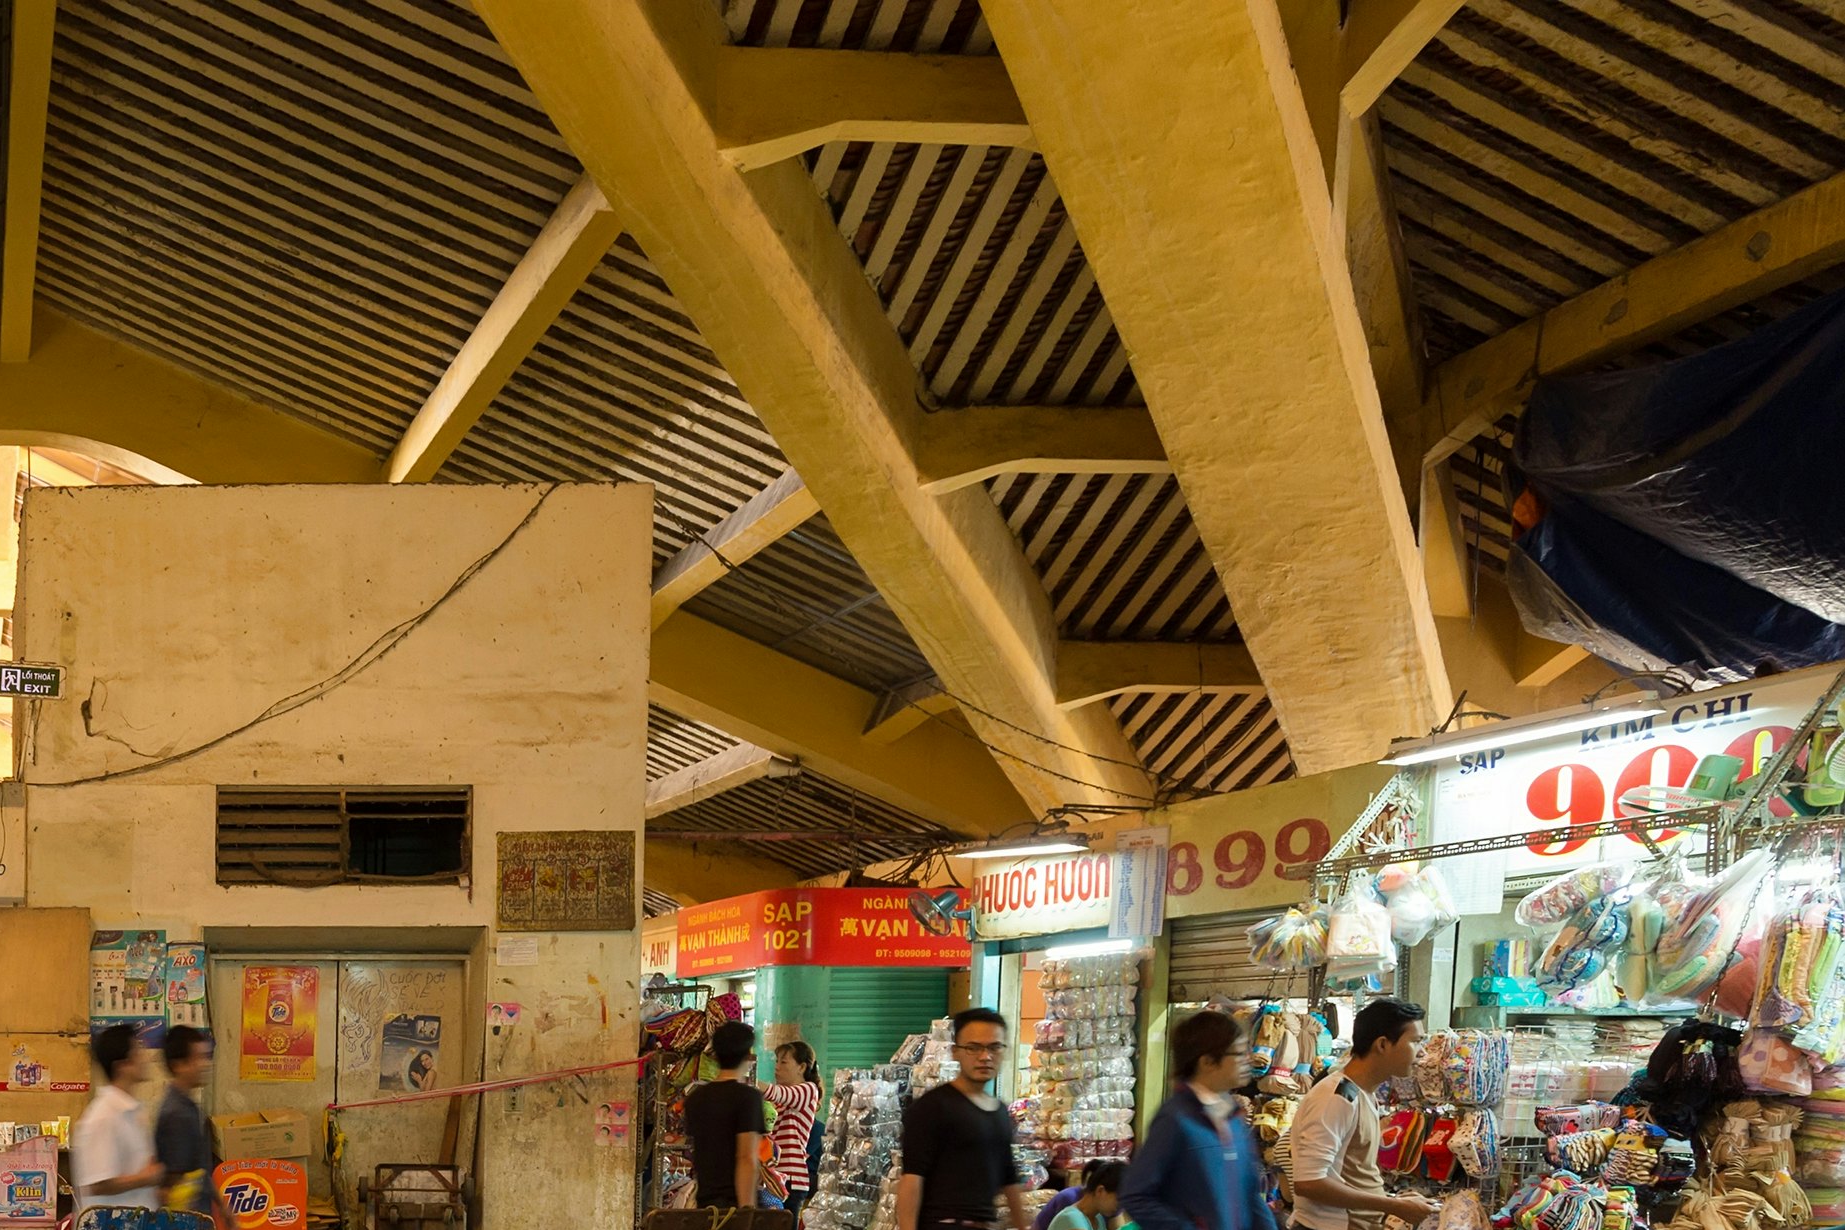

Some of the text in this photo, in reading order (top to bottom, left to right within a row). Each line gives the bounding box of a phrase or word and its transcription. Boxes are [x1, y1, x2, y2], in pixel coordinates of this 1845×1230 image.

[23, 683, 51, 693] EXIT
[1579, 692, 1753, 752] KIM CHI
[1460, 747, 1505, 776] SAP
[1166, 817, 1331, 896] 899
[763, 902, 813, 926] SẠP
[687, 931, 705, 953] VẠN
[708, 922, 741, 947] THÀNH
[763, 929, 813, 950] 1021
[861, 918, 908, 940] VẠN
[174, 955, 197, 967] AXO
[649, 941, 670, 968] ANH
[51, 1081, 85, 1091] Colgate
[15, 1186, 42, 1197] Klin
[223, 1183, 269, 1215] Tide
